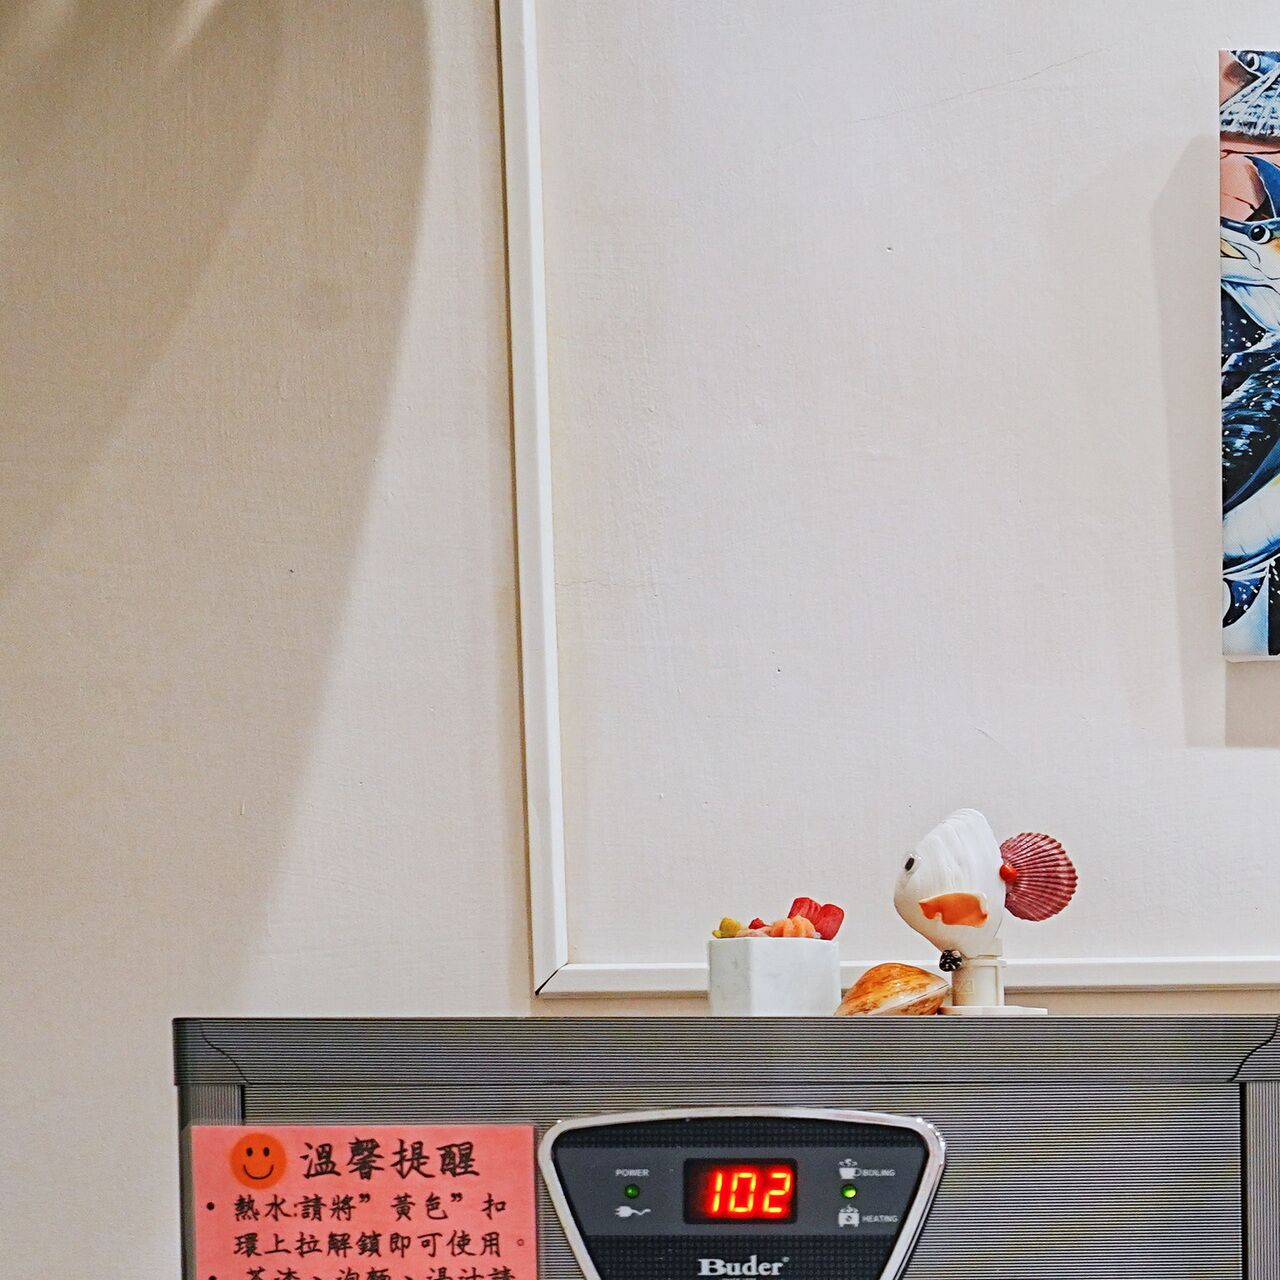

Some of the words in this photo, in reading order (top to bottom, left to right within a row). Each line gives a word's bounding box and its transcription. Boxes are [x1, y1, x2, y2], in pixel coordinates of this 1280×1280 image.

[300, 1137, 480, 1181] 溫馨提醒
[615, 1168, 649, 1177] POWER
[711, 1172, 791, 1213] 102
[862, 1214, 898, 1223] HEATING
[697, 1256, 784, 1277] Buder
